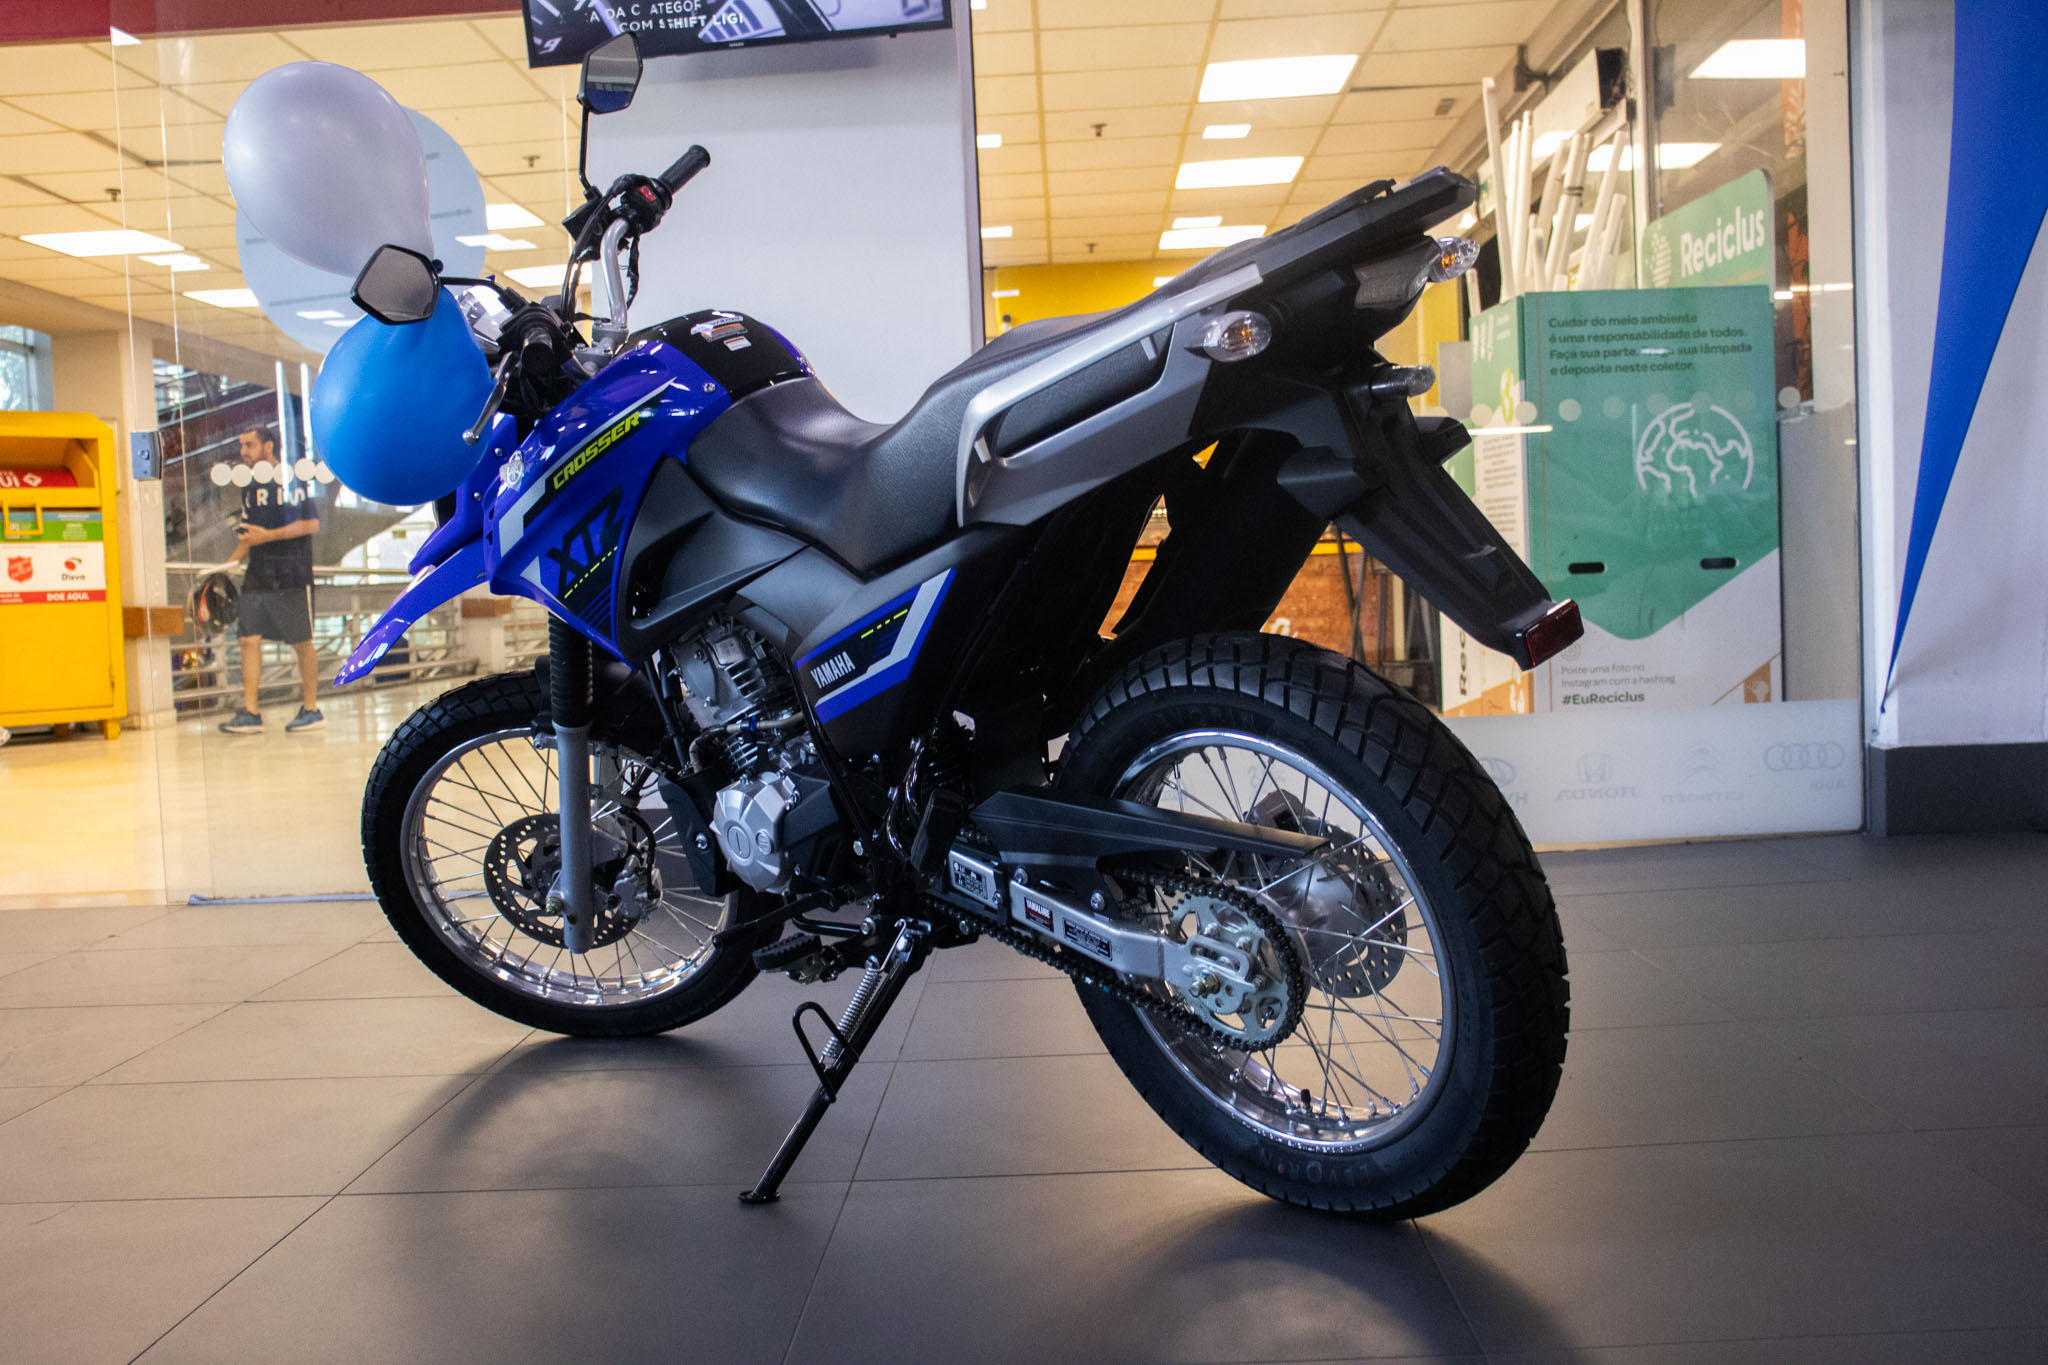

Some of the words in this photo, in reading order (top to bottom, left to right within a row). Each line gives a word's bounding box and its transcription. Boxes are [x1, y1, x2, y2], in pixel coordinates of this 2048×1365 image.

[619, 20, 653, 33] COM
[1681, 206, 1765, 278] Reciclus
[1548, 317, 1587, 329] Cuidar
[1590, 316, 1607, 327] do
[1608, 314, 1639, 326] meio
[1640, 313, 1697, 325] ambiente
[1549, 332, 1556, 344] é
[1559, 335, 1585, 344] uma
[1587, 329, 1691, 344] responsabilidade
[1692, 328, 1708, 338] de
[1550, 349, 1577, 361] Faça
[1580, 350, 1600, 359] sua
[1603, 347, 1639, 360] parte.
[1678, 346, 1697, 354] sua
[1700, 342, 1752, 355] lâmpada
[1550, 366, 1557, 375] e
[1560, 363, 1613, 376] deposite
[1615, 363, 1648, 373] neste
[1650, 361, 1694, 372] coletor.
[553, 410, 640, 490] CROSSER
[810, 650, 856, 689] YAMAHA
[1633, 664, 1645, 672] no
[1563, 691, 1645, 705] #EuReciclus
